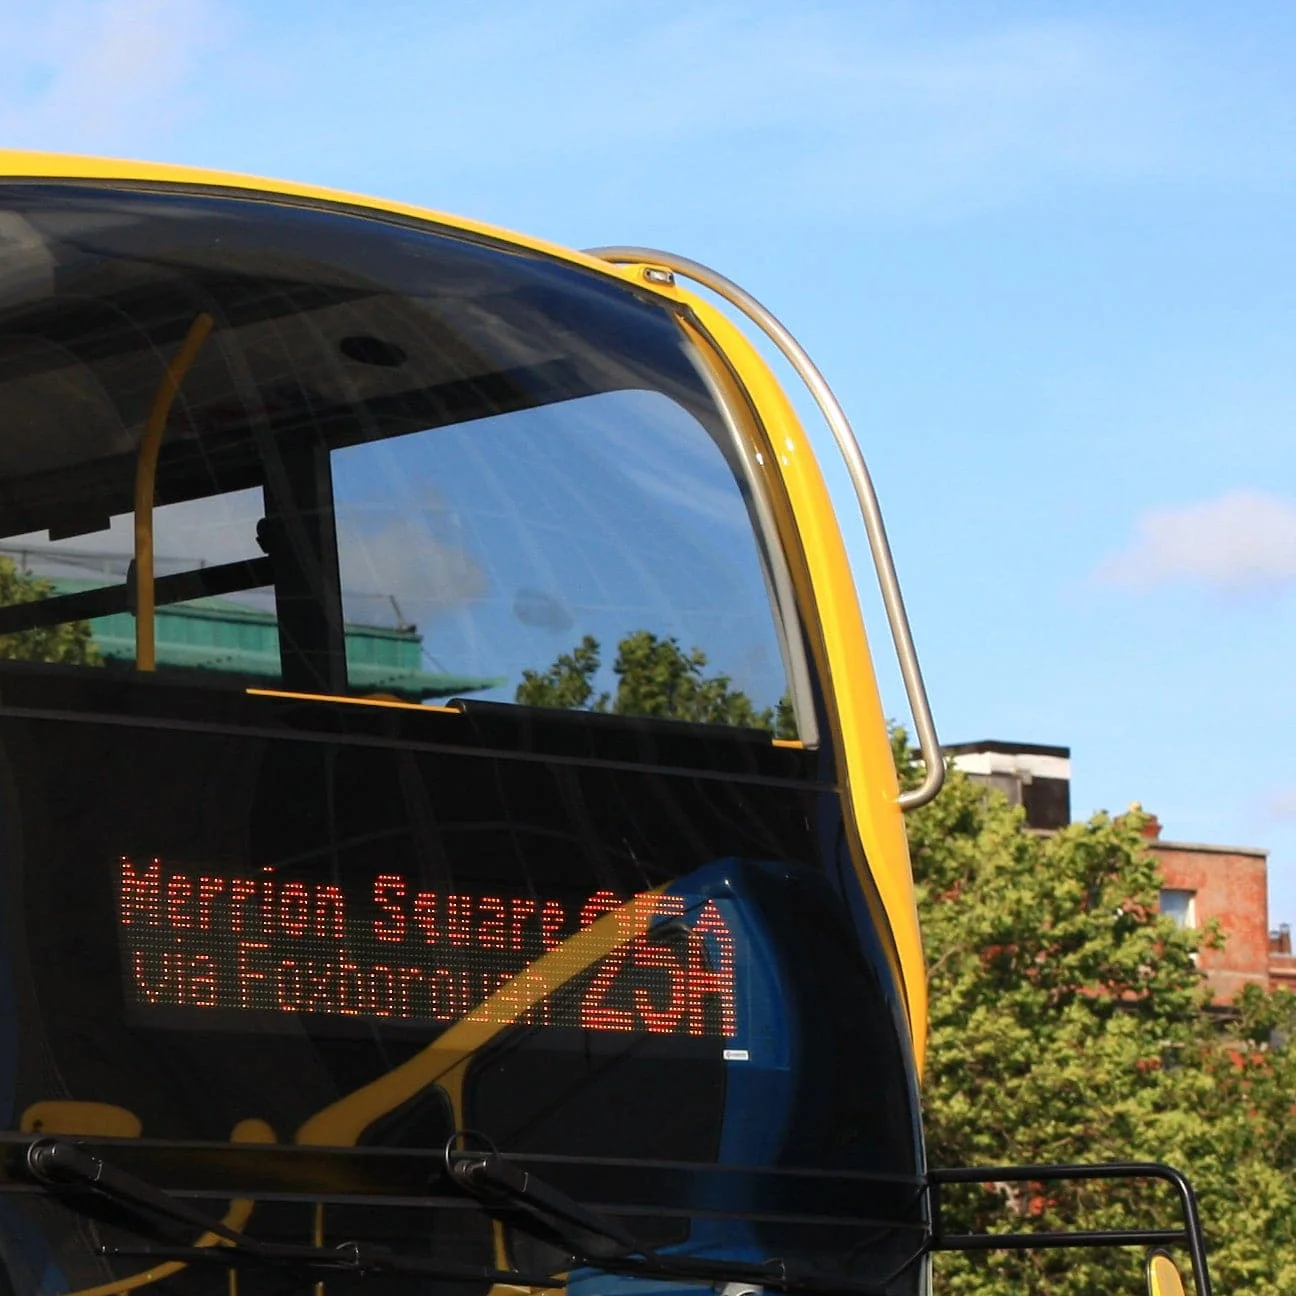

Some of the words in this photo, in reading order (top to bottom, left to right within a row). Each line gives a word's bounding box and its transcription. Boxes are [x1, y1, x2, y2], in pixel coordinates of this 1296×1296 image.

[121, 855, 344, 939] Merrion
[374, 873, 568, 953] Square
[134, 936, 216, 1007] via
[577, 890, 738, 1038] 25A
